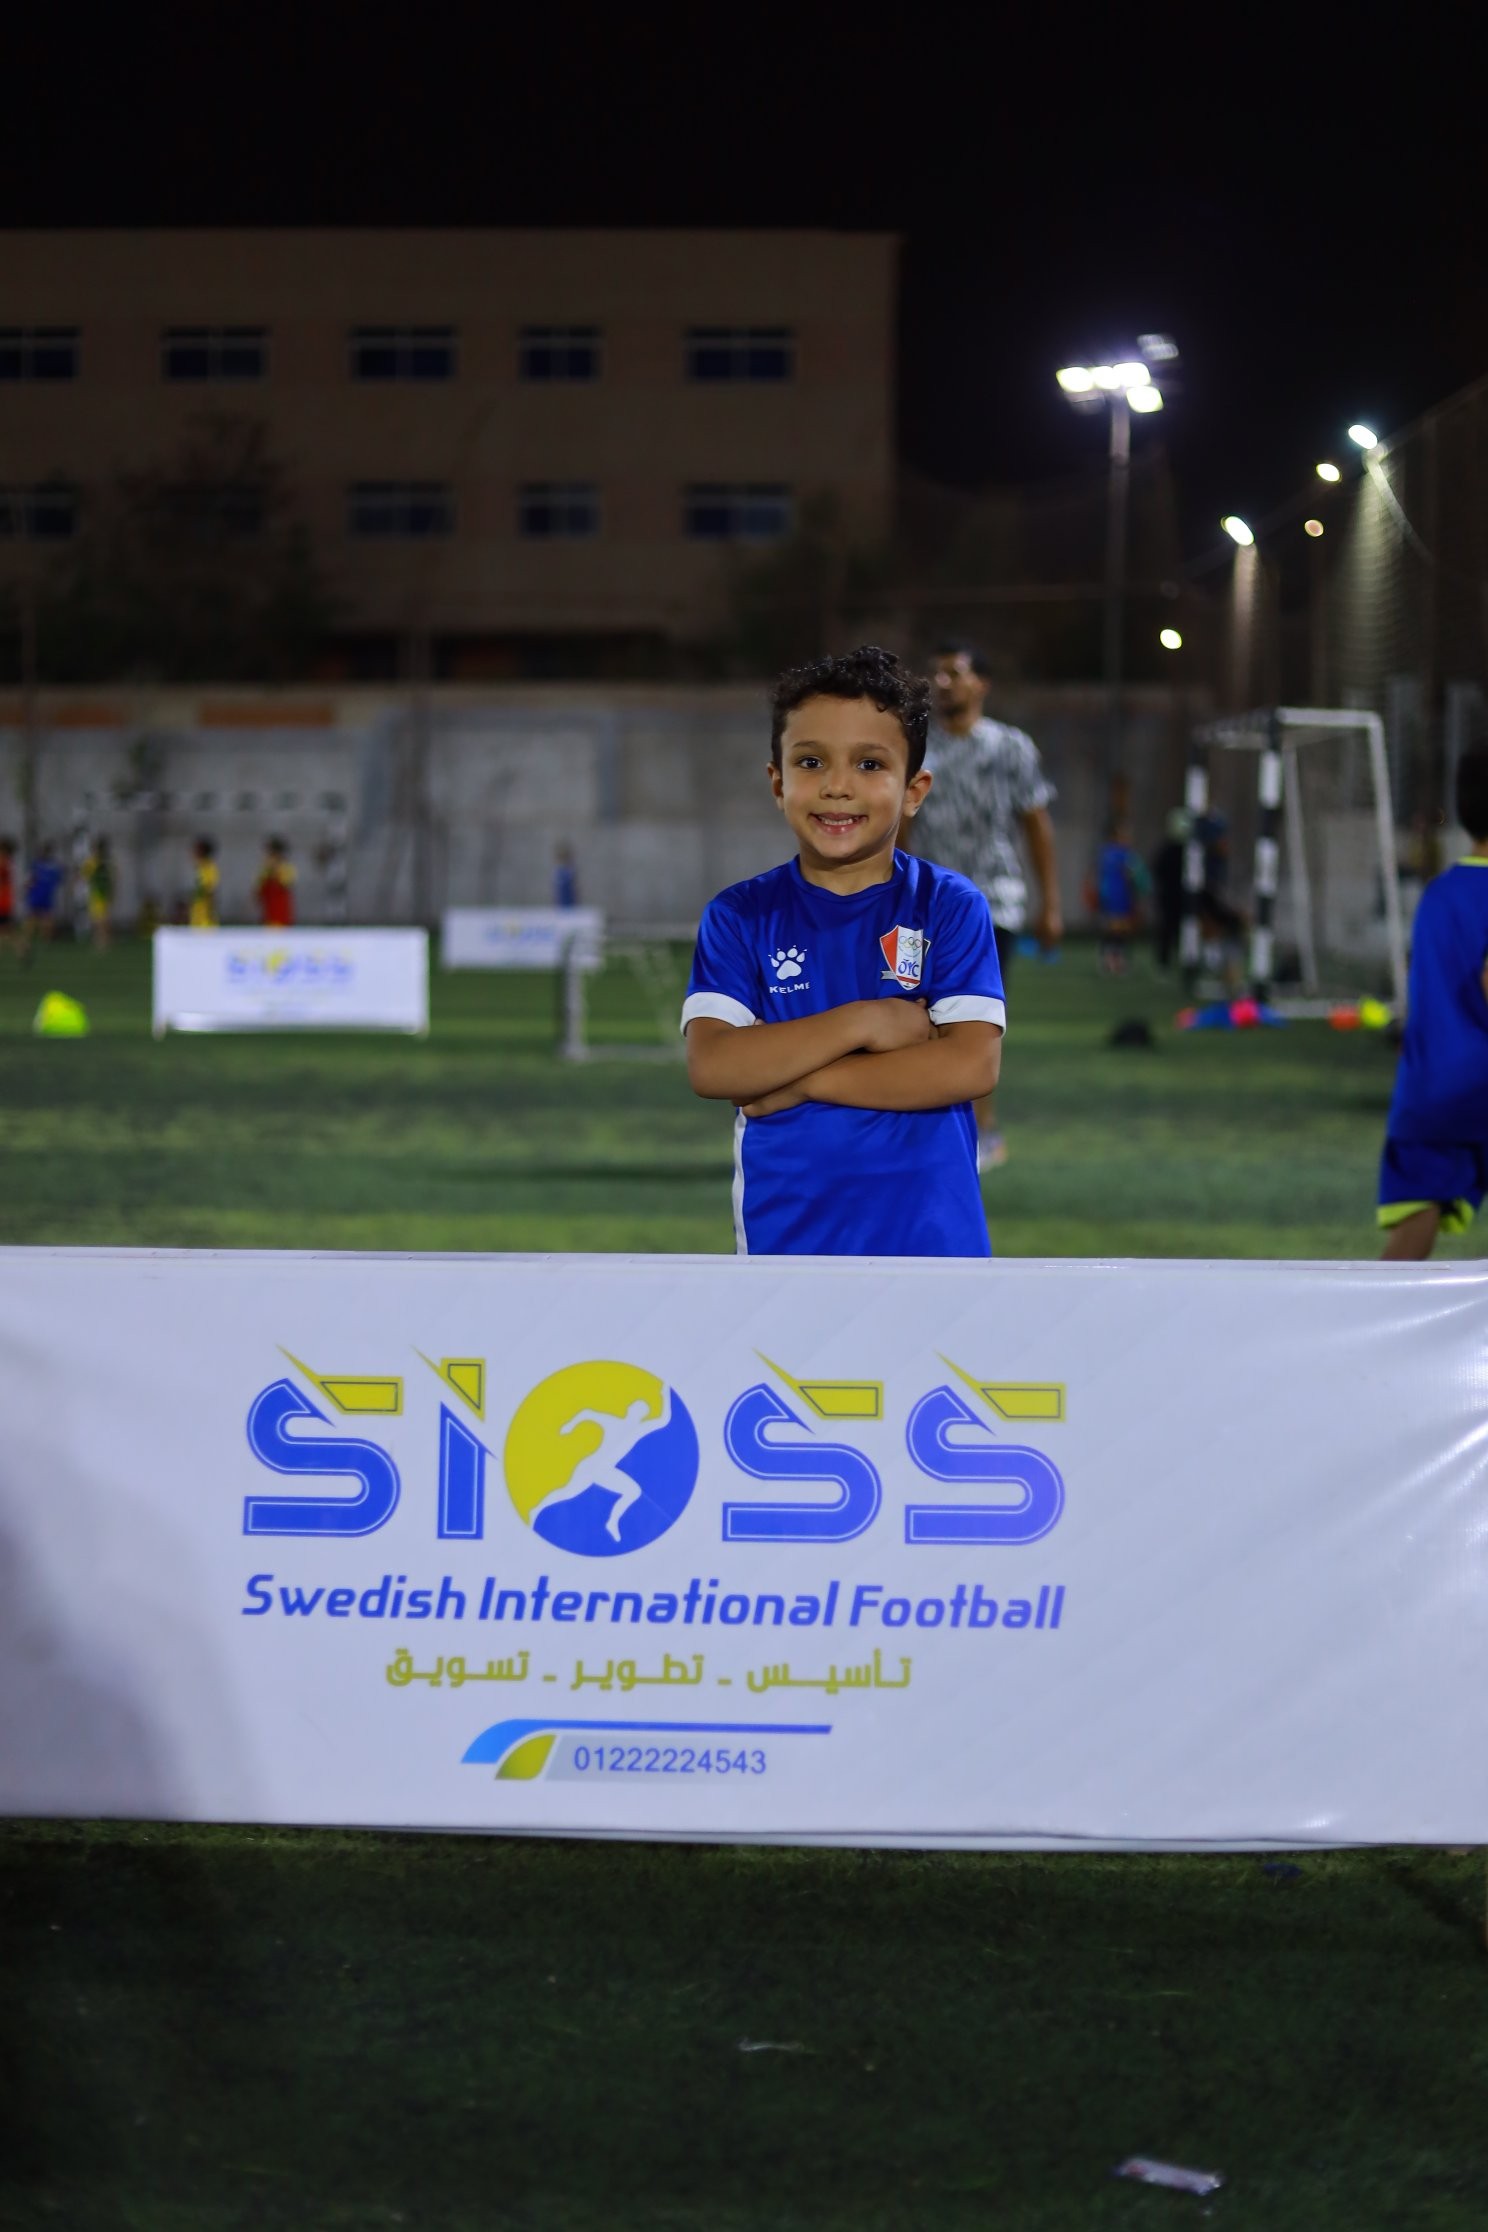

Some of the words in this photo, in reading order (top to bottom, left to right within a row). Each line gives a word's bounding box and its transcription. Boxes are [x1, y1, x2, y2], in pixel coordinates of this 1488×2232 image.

[242, 1343, 1066, 1557] SIOSS
[242, 1573, 467, 1620] Swedish
[478, 1576, 840, 1627] International
[849, 1584, 1065, 1629] Football
[386, 1648, 530, 1688] تسويق
[570, 1653, 704, 1691] تطوير
[574, 1746, 767, 1774] 01222224543
